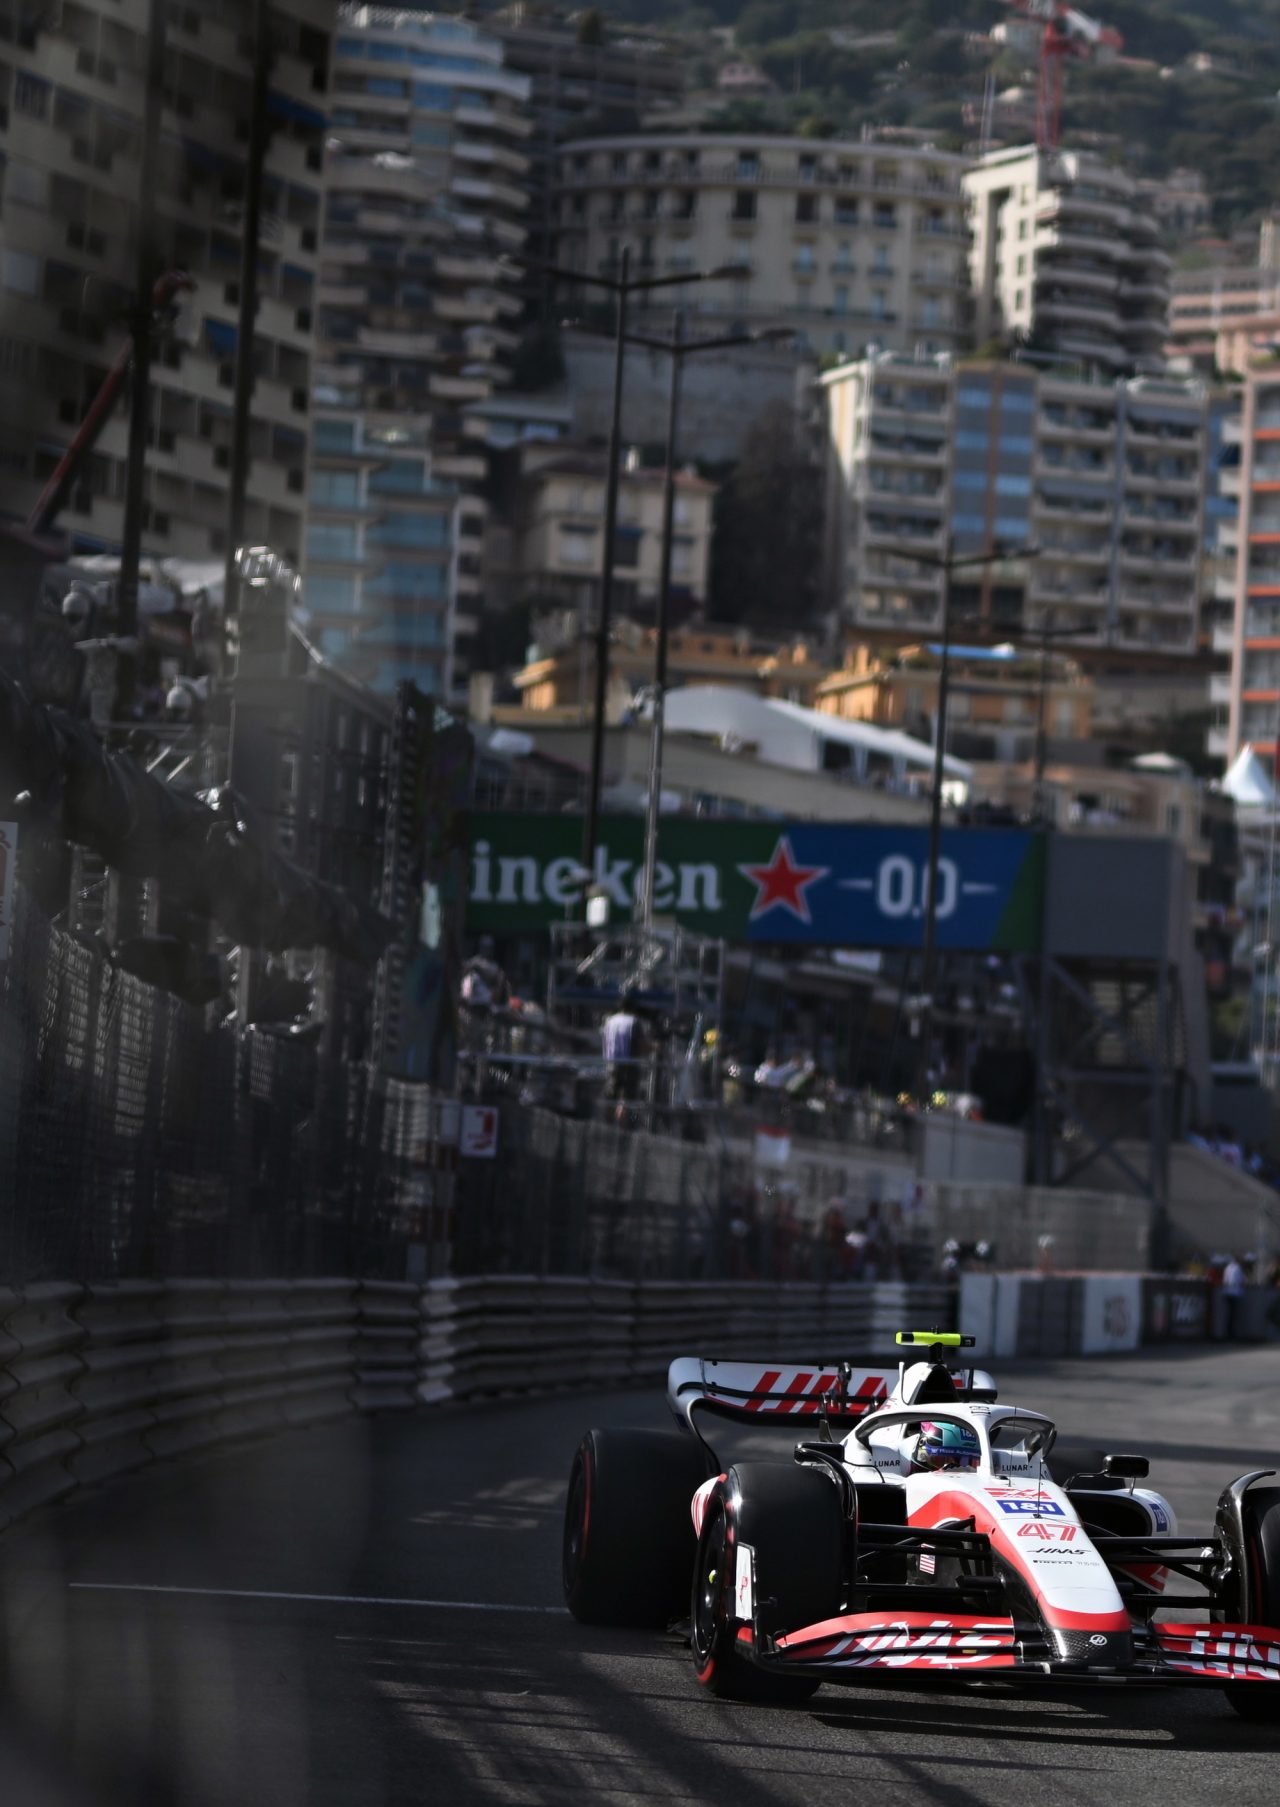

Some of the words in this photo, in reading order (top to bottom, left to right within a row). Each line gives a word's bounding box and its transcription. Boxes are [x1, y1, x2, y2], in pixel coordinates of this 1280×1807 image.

[879, 854, 957, 919] 0.0
[874, 1459, 901, 1468] LUNAR
[1001, 1464, 1028, 1472] LUNAR
[1002, 1502, 1056, 1512] 1&1
[1017, 1523, 1077, 1541] 47
[1033, 1547, 1087, 1555] HAAS
